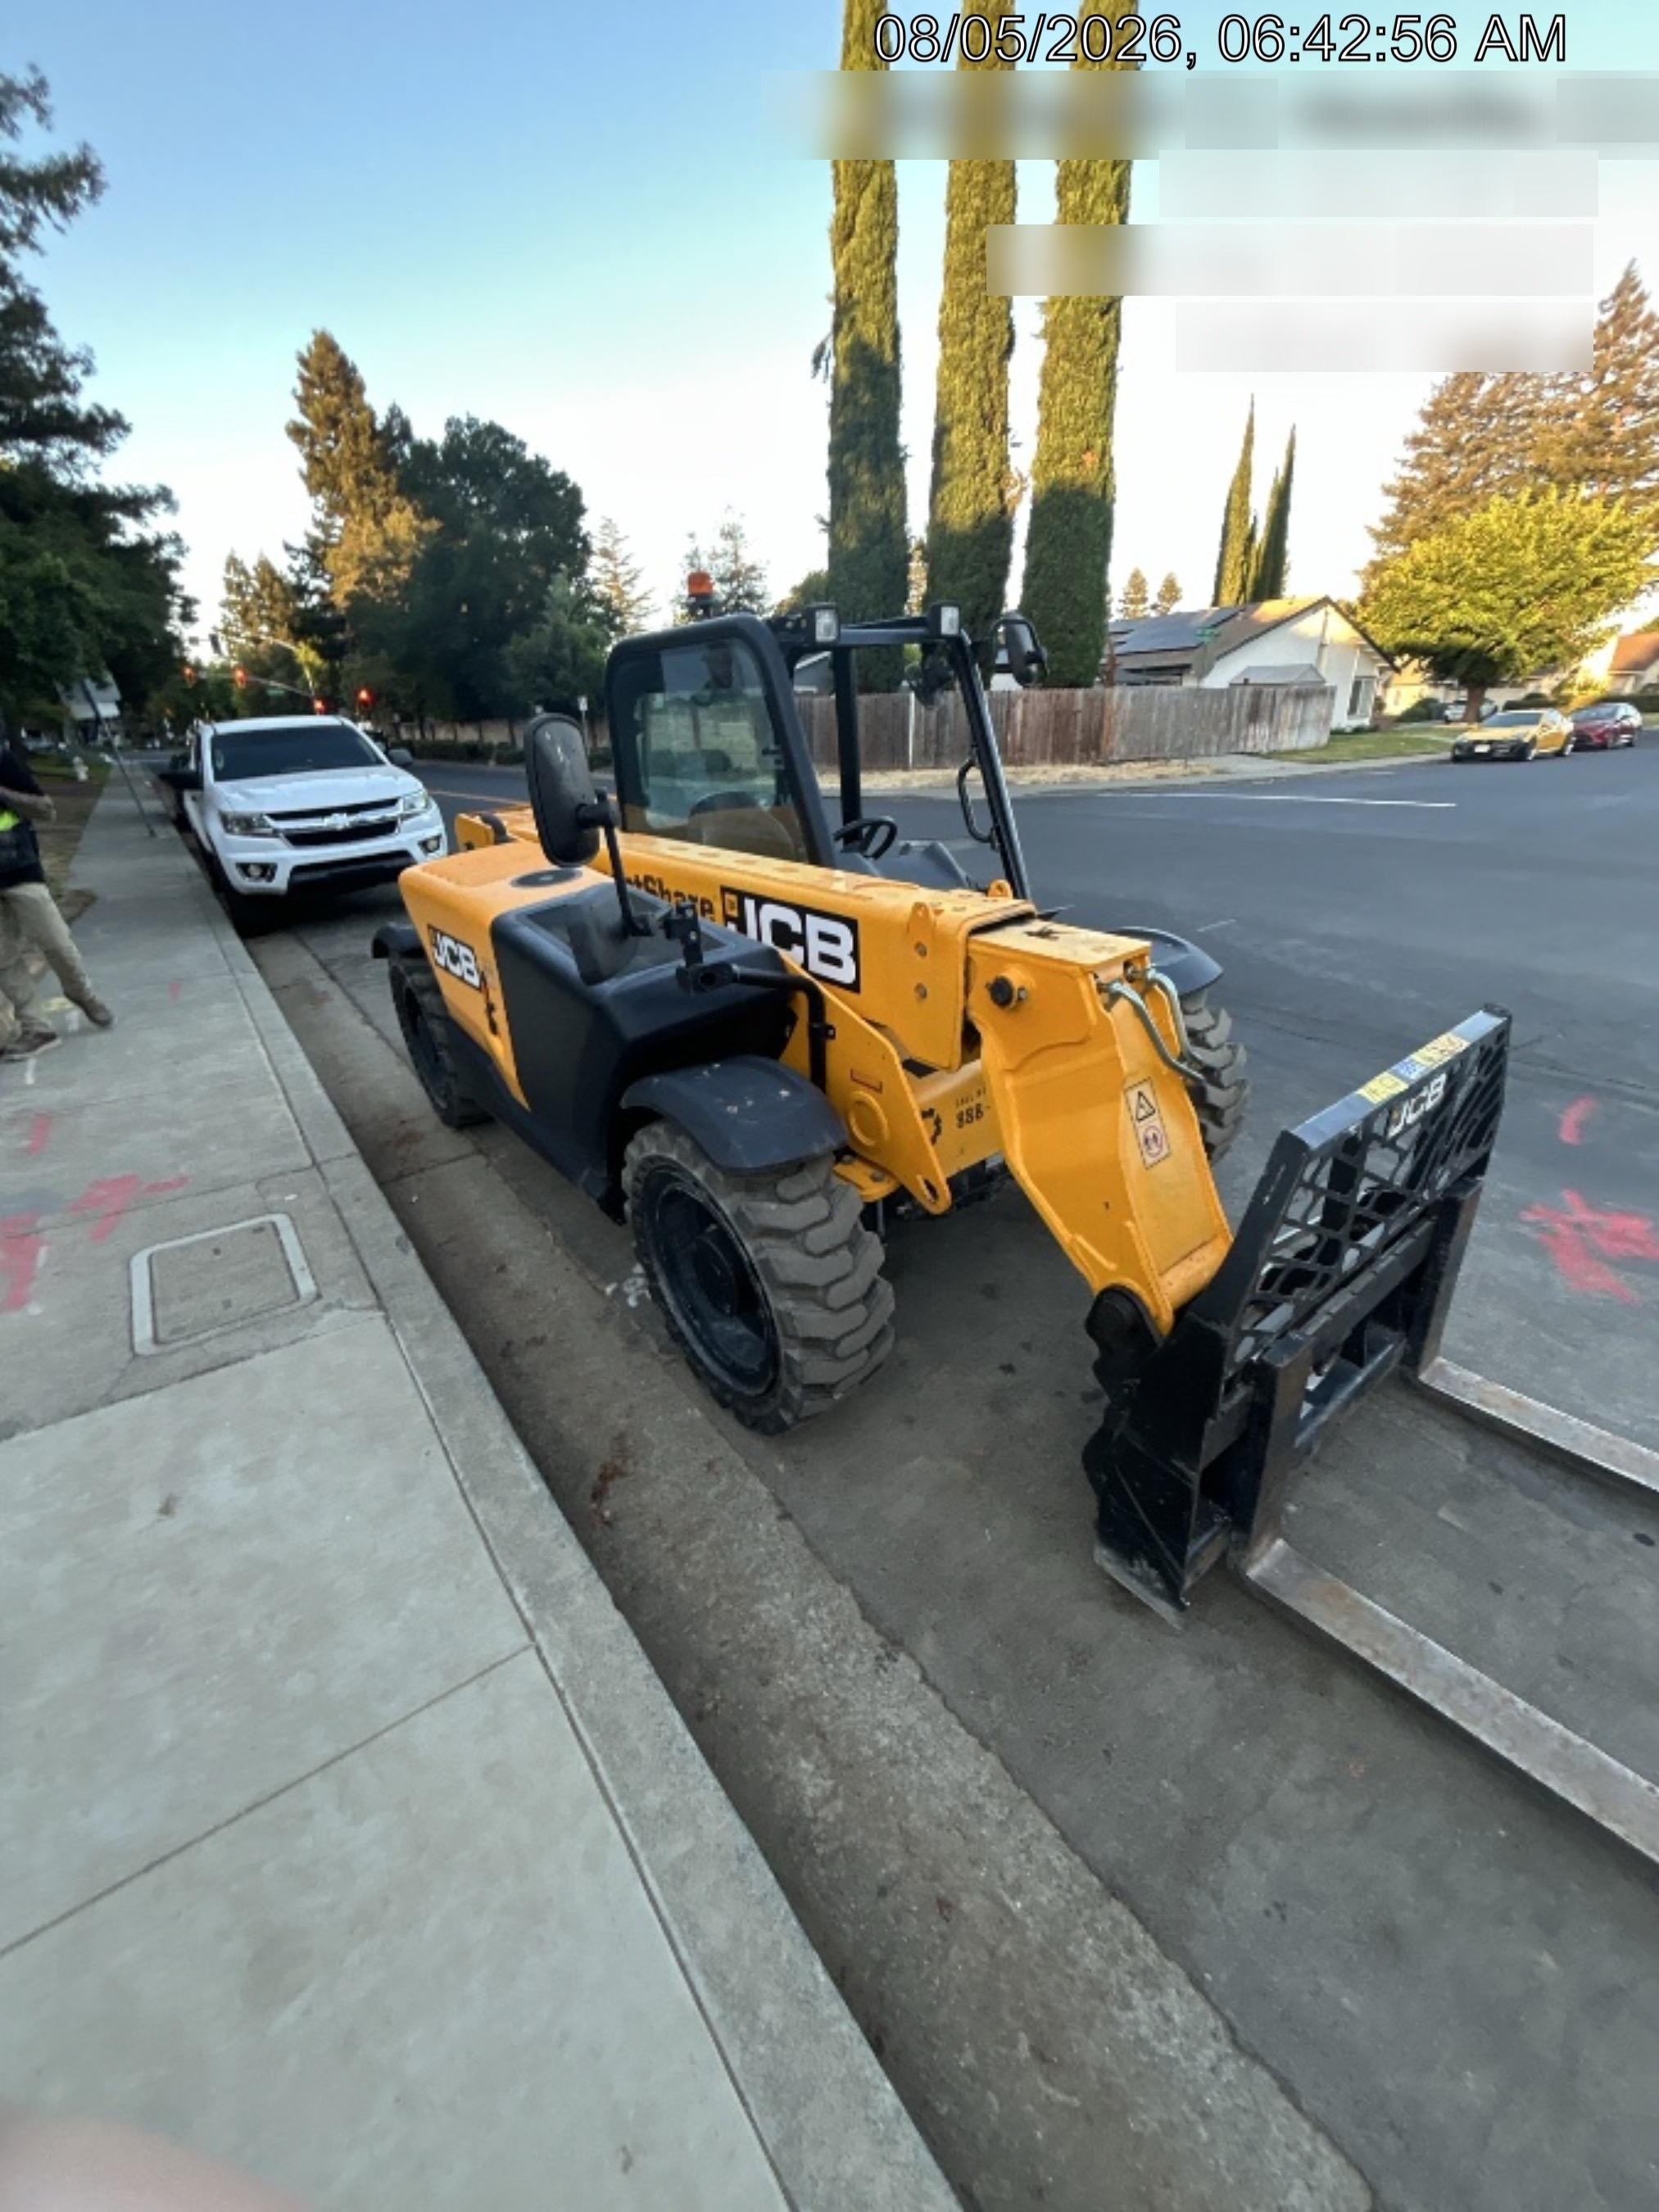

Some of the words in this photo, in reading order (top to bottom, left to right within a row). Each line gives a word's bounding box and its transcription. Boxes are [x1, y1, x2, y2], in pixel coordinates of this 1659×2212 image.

[625, 874, 716, 922] tShare
[433, 931, 481, 988] JCB
[725, 897, 857, 985] JCB
[1388, 1072, 1448, 1139] JCB
